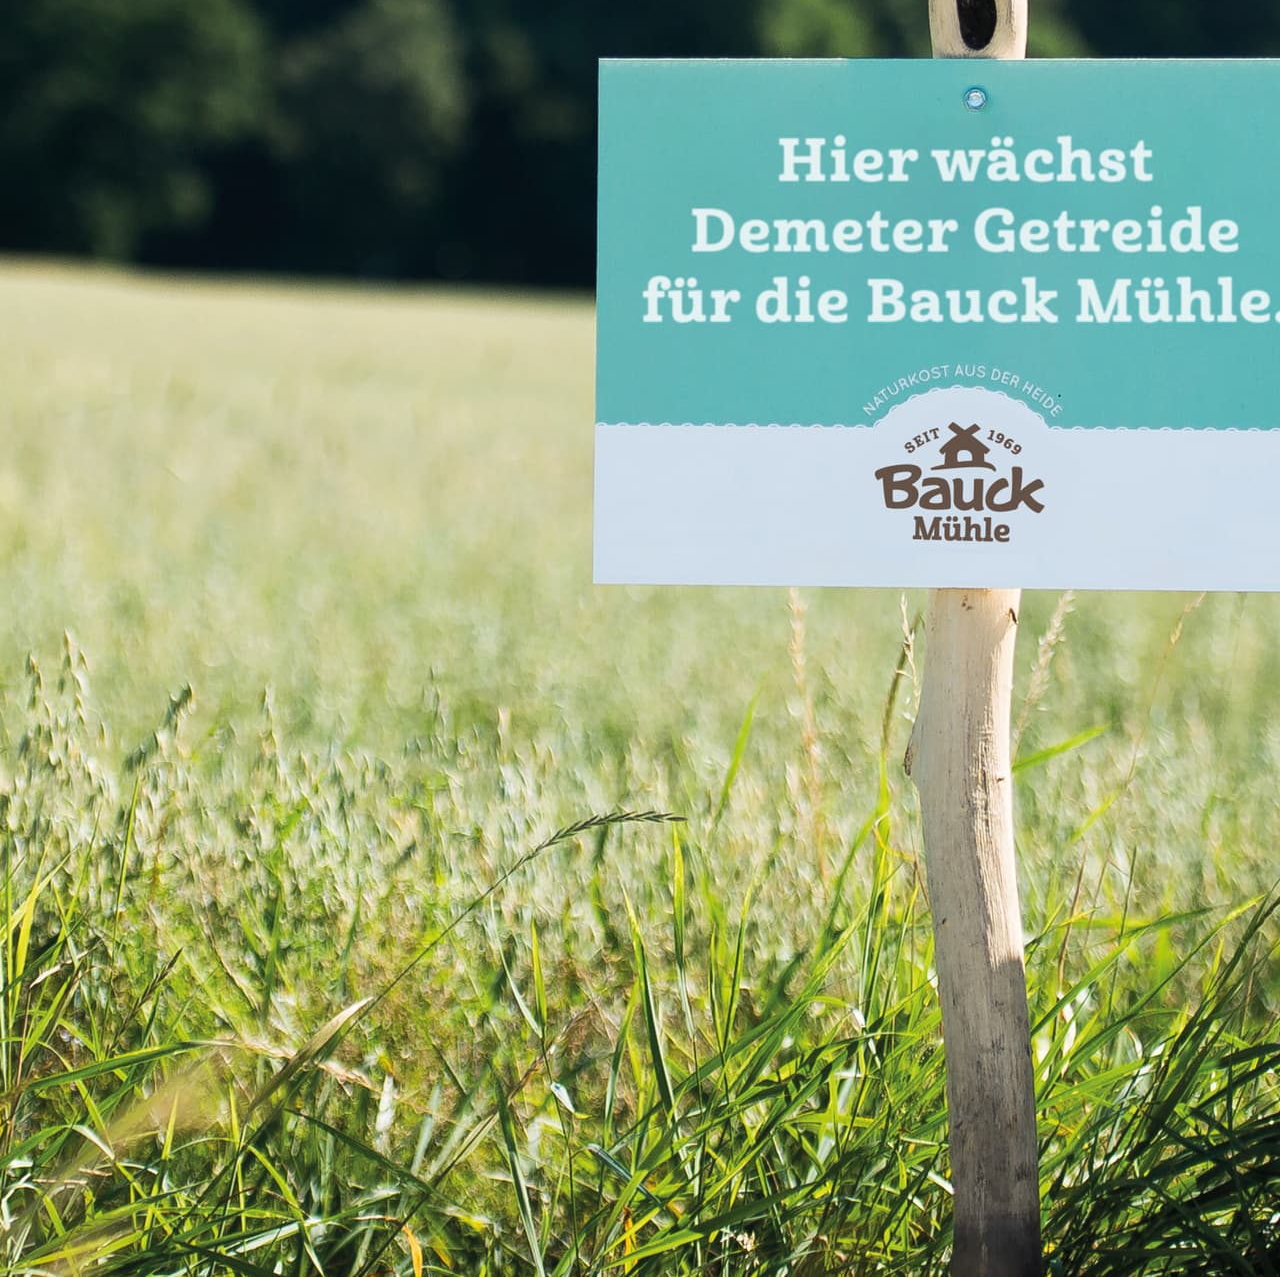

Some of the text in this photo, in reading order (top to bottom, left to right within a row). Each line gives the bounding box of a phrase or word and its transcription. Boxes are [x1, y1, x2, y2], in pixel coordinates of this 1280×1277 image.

[778, 134, 1153, 183] Hier wächst
[691, 205, 1239, 253] Demeter Getreide
[642, 275, 741, 323] für
[755, 275, 848, 323] die
[867, 276, 1059, 323] Bauck
[862, 363, 1064, 418] NATURKOST AUS DER HEIDE
[904, 427, 1022, 455] SEIT 1969
[874, 463, 1045, 514] Bauck
[912, 515, 1010, 543] Mühle
